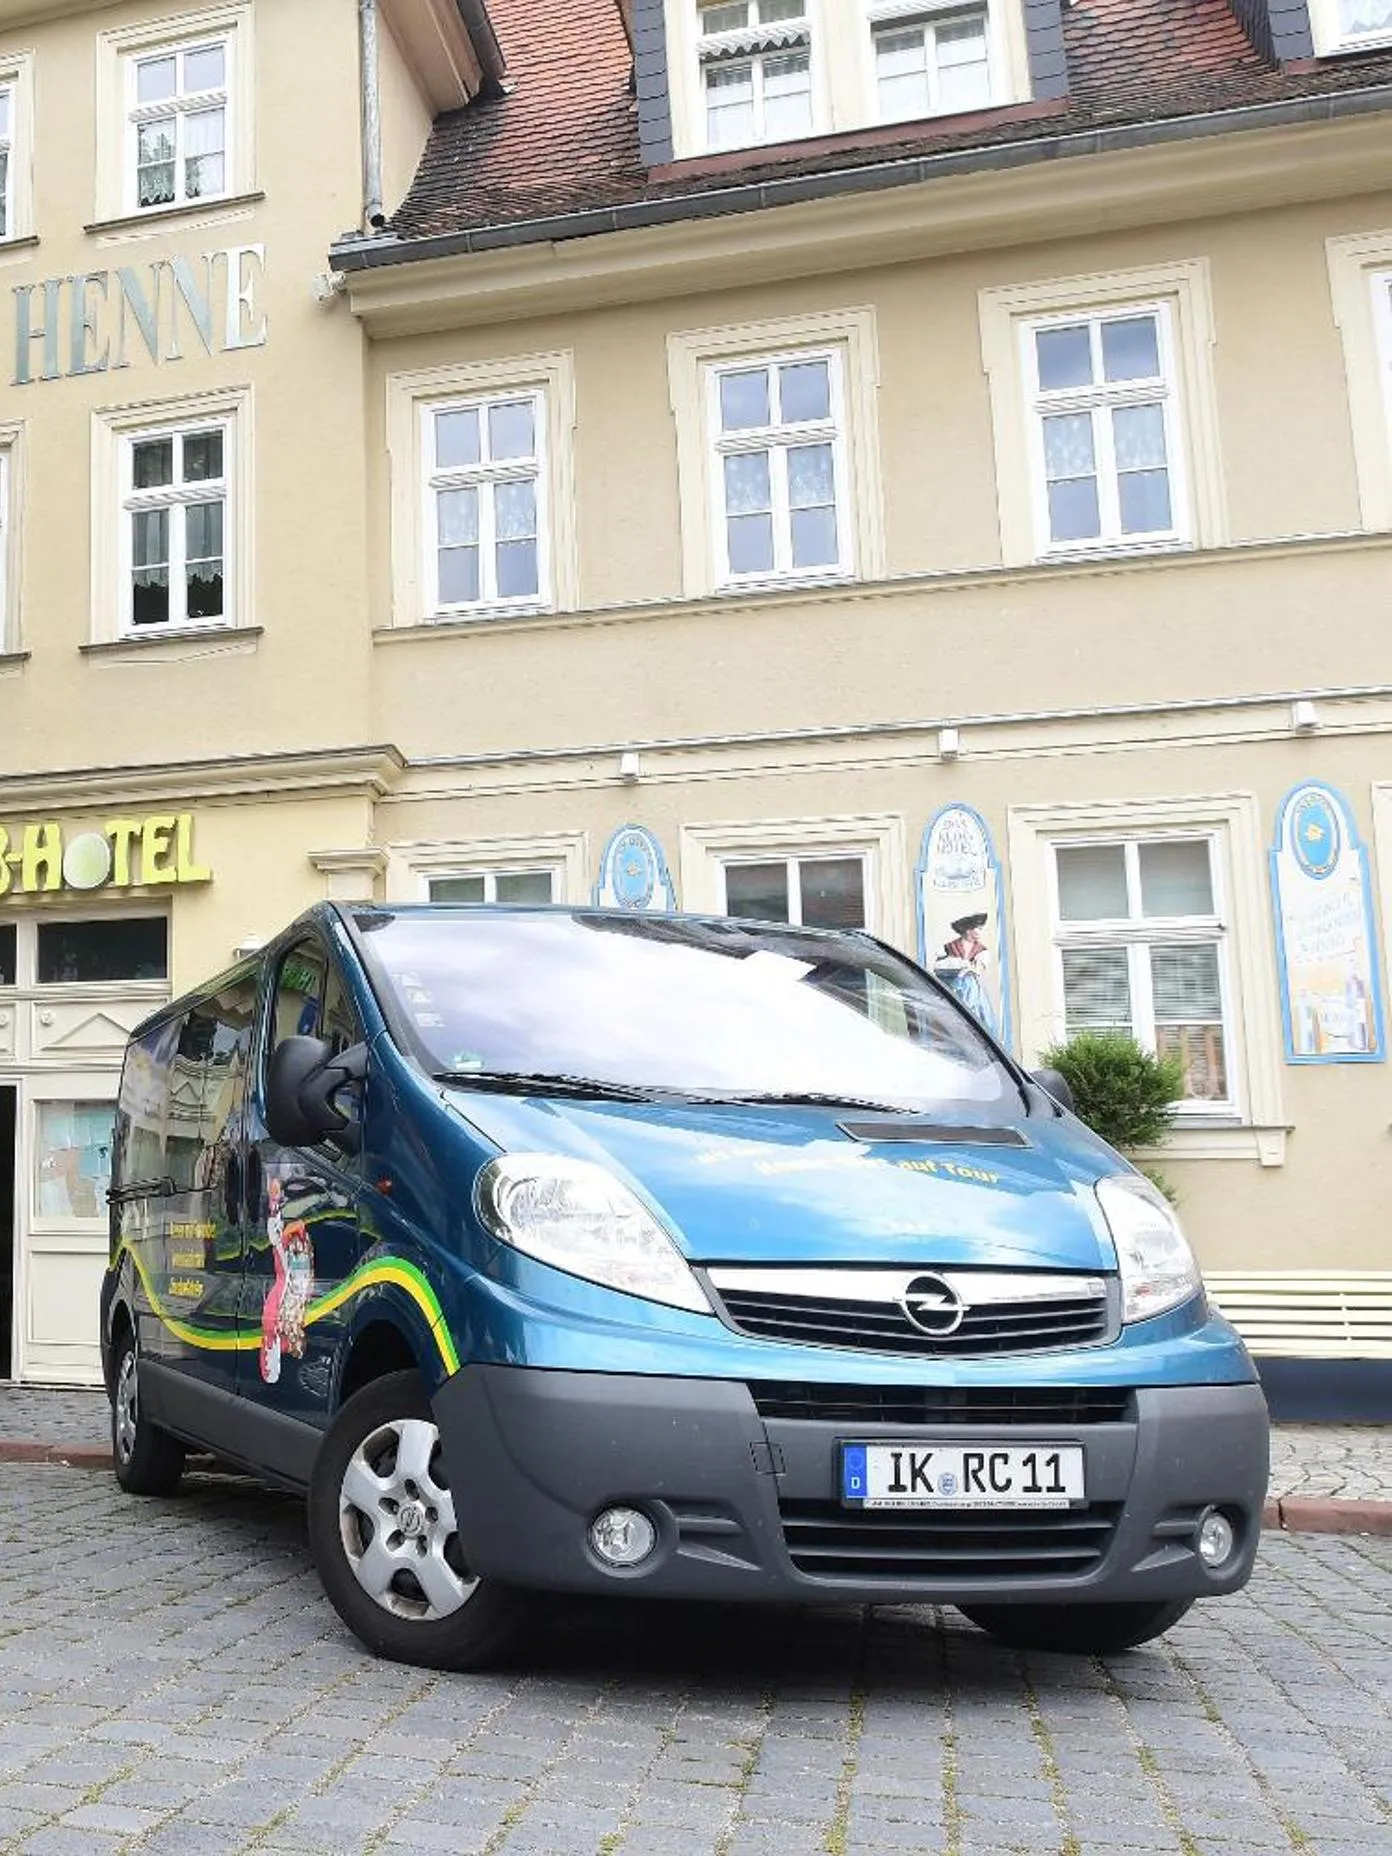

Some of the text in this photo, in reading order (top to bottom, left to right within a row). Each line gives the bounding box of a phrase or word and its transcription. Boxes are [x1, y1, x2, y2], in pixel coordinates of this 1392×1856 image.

[9, 243, 269, 388] HENNE
[940, 1162, 999, 1184] Tour
[888, 1452, 935, 1494] IK
